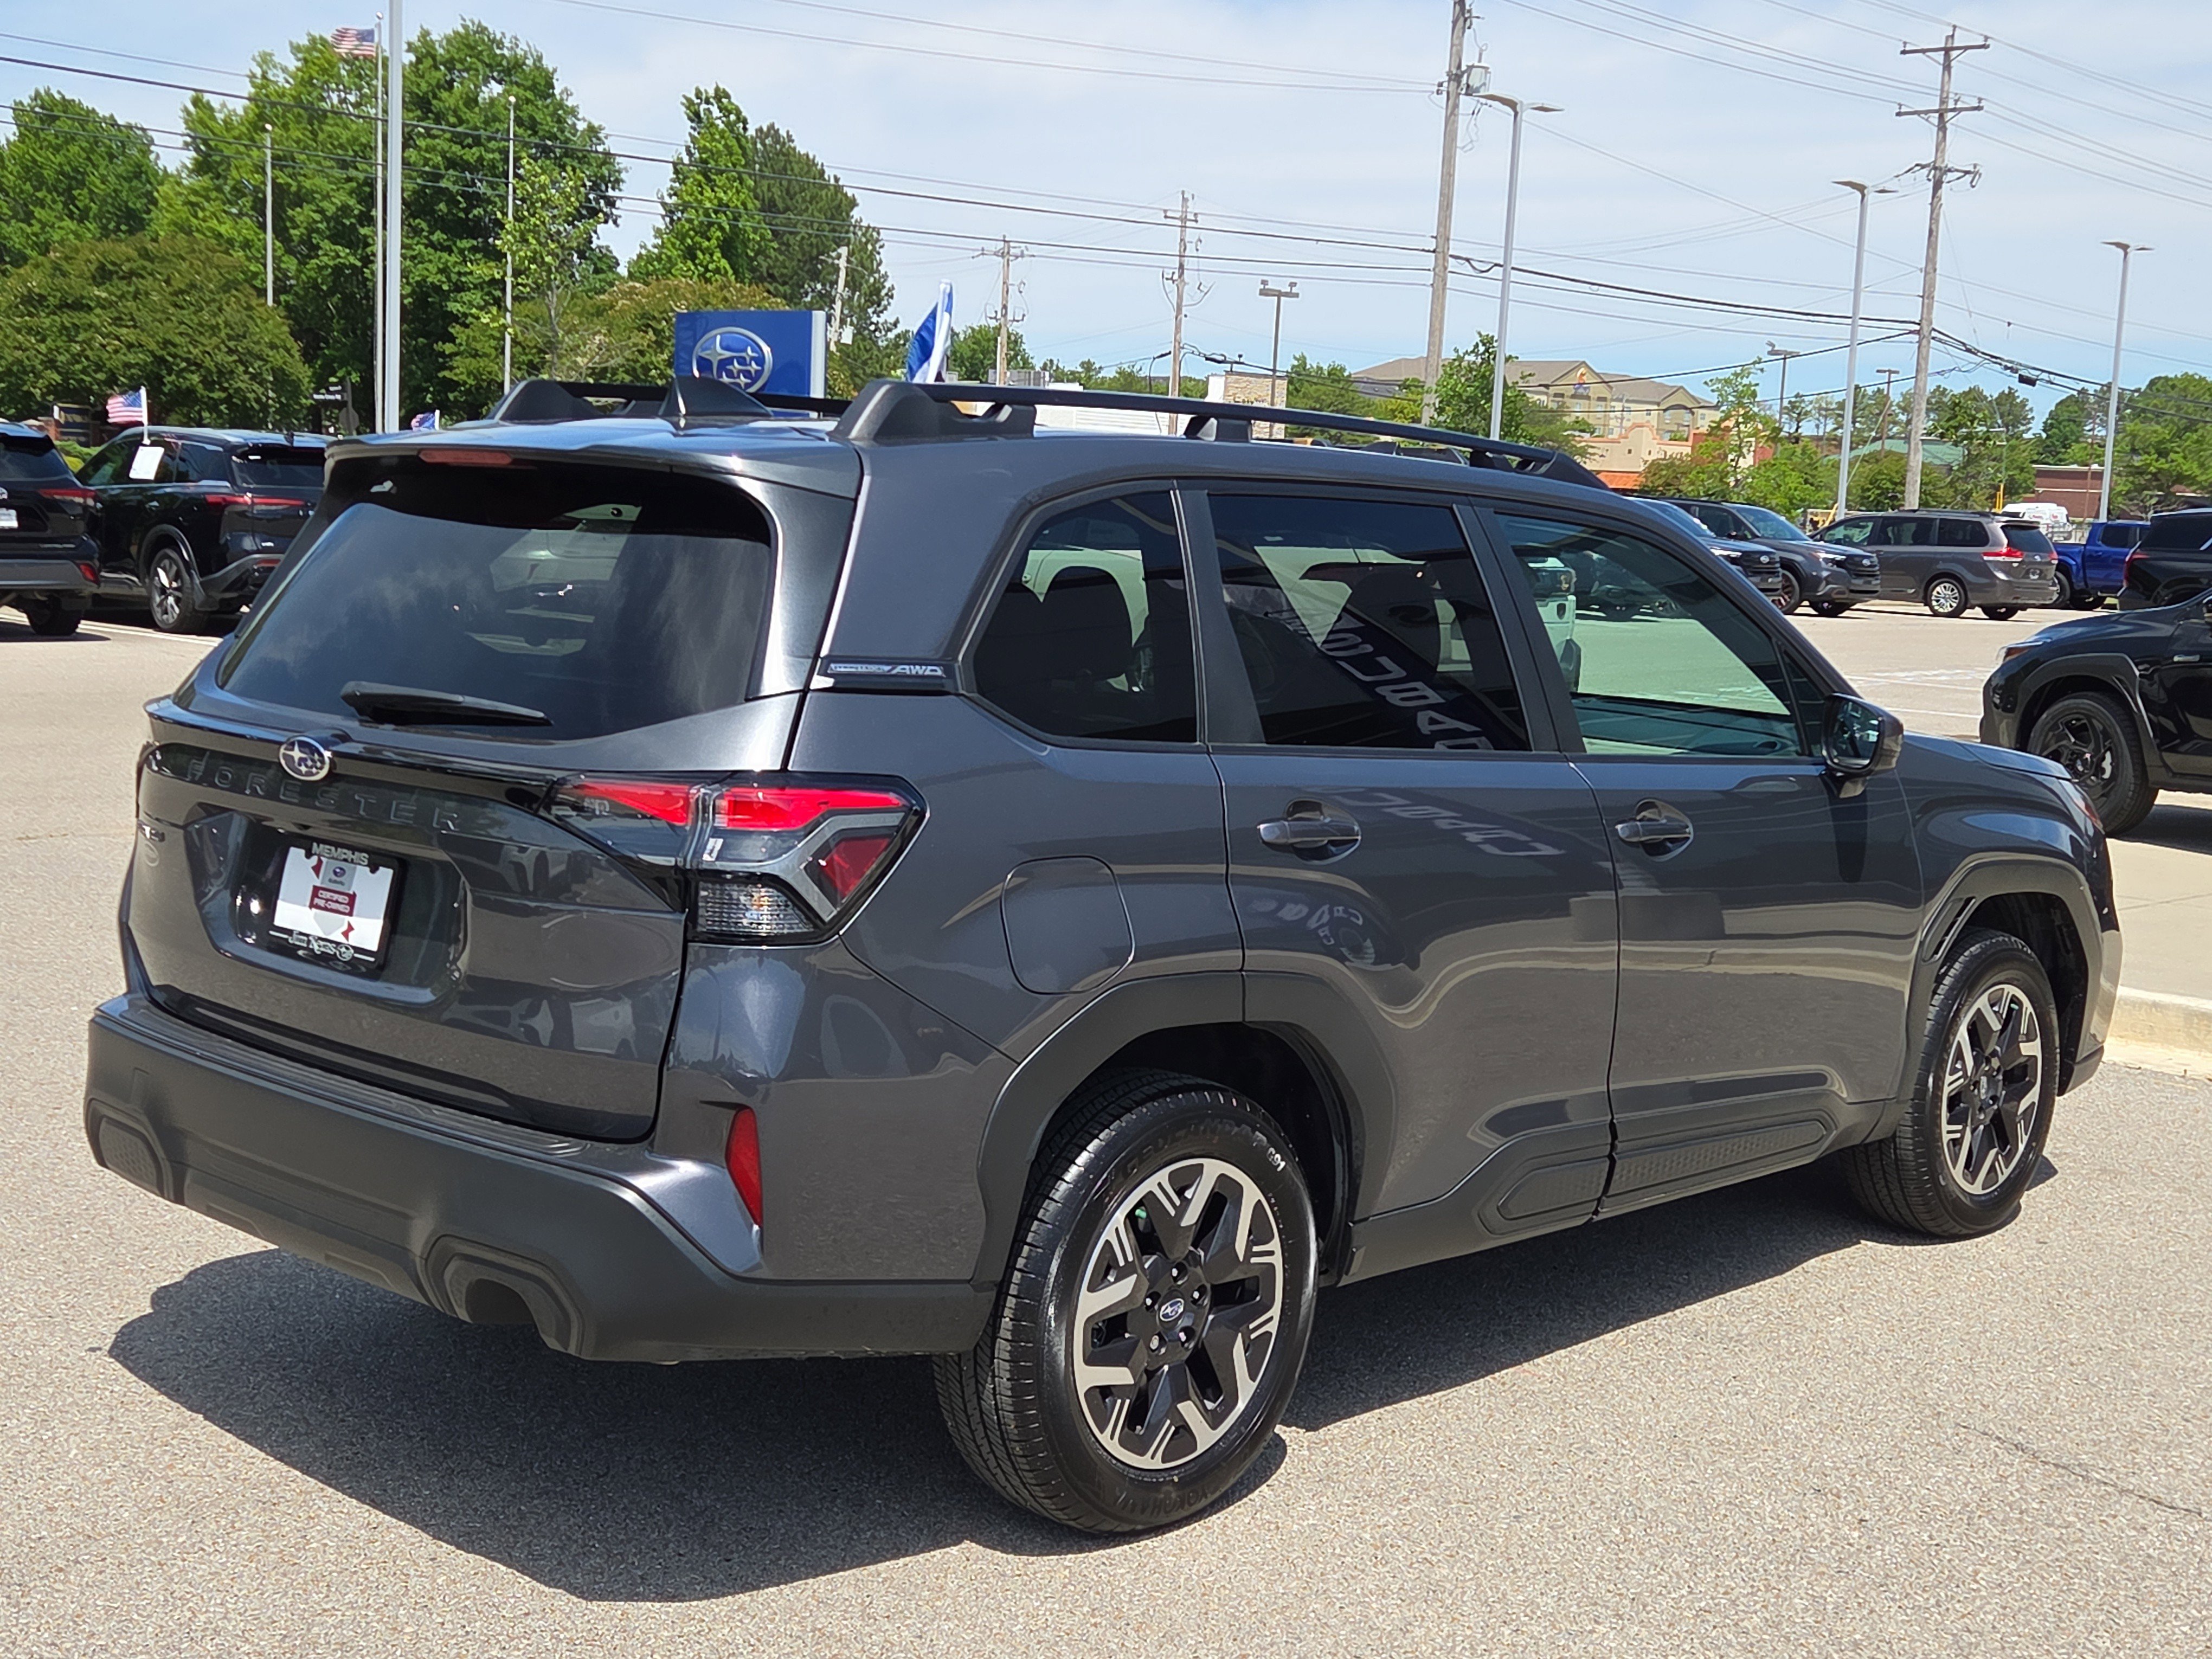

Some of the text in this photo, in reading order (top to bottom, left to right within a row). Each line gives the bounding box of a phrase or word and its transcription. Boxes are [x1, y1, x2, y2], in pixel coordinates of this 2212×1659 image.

[891, 665, 943, 676] AWD
[187, 759, 460, 832] FORESTER
[312, 842, 369, 865] MEMPHIS
[1266, 1147, 1287, 1172] G91
